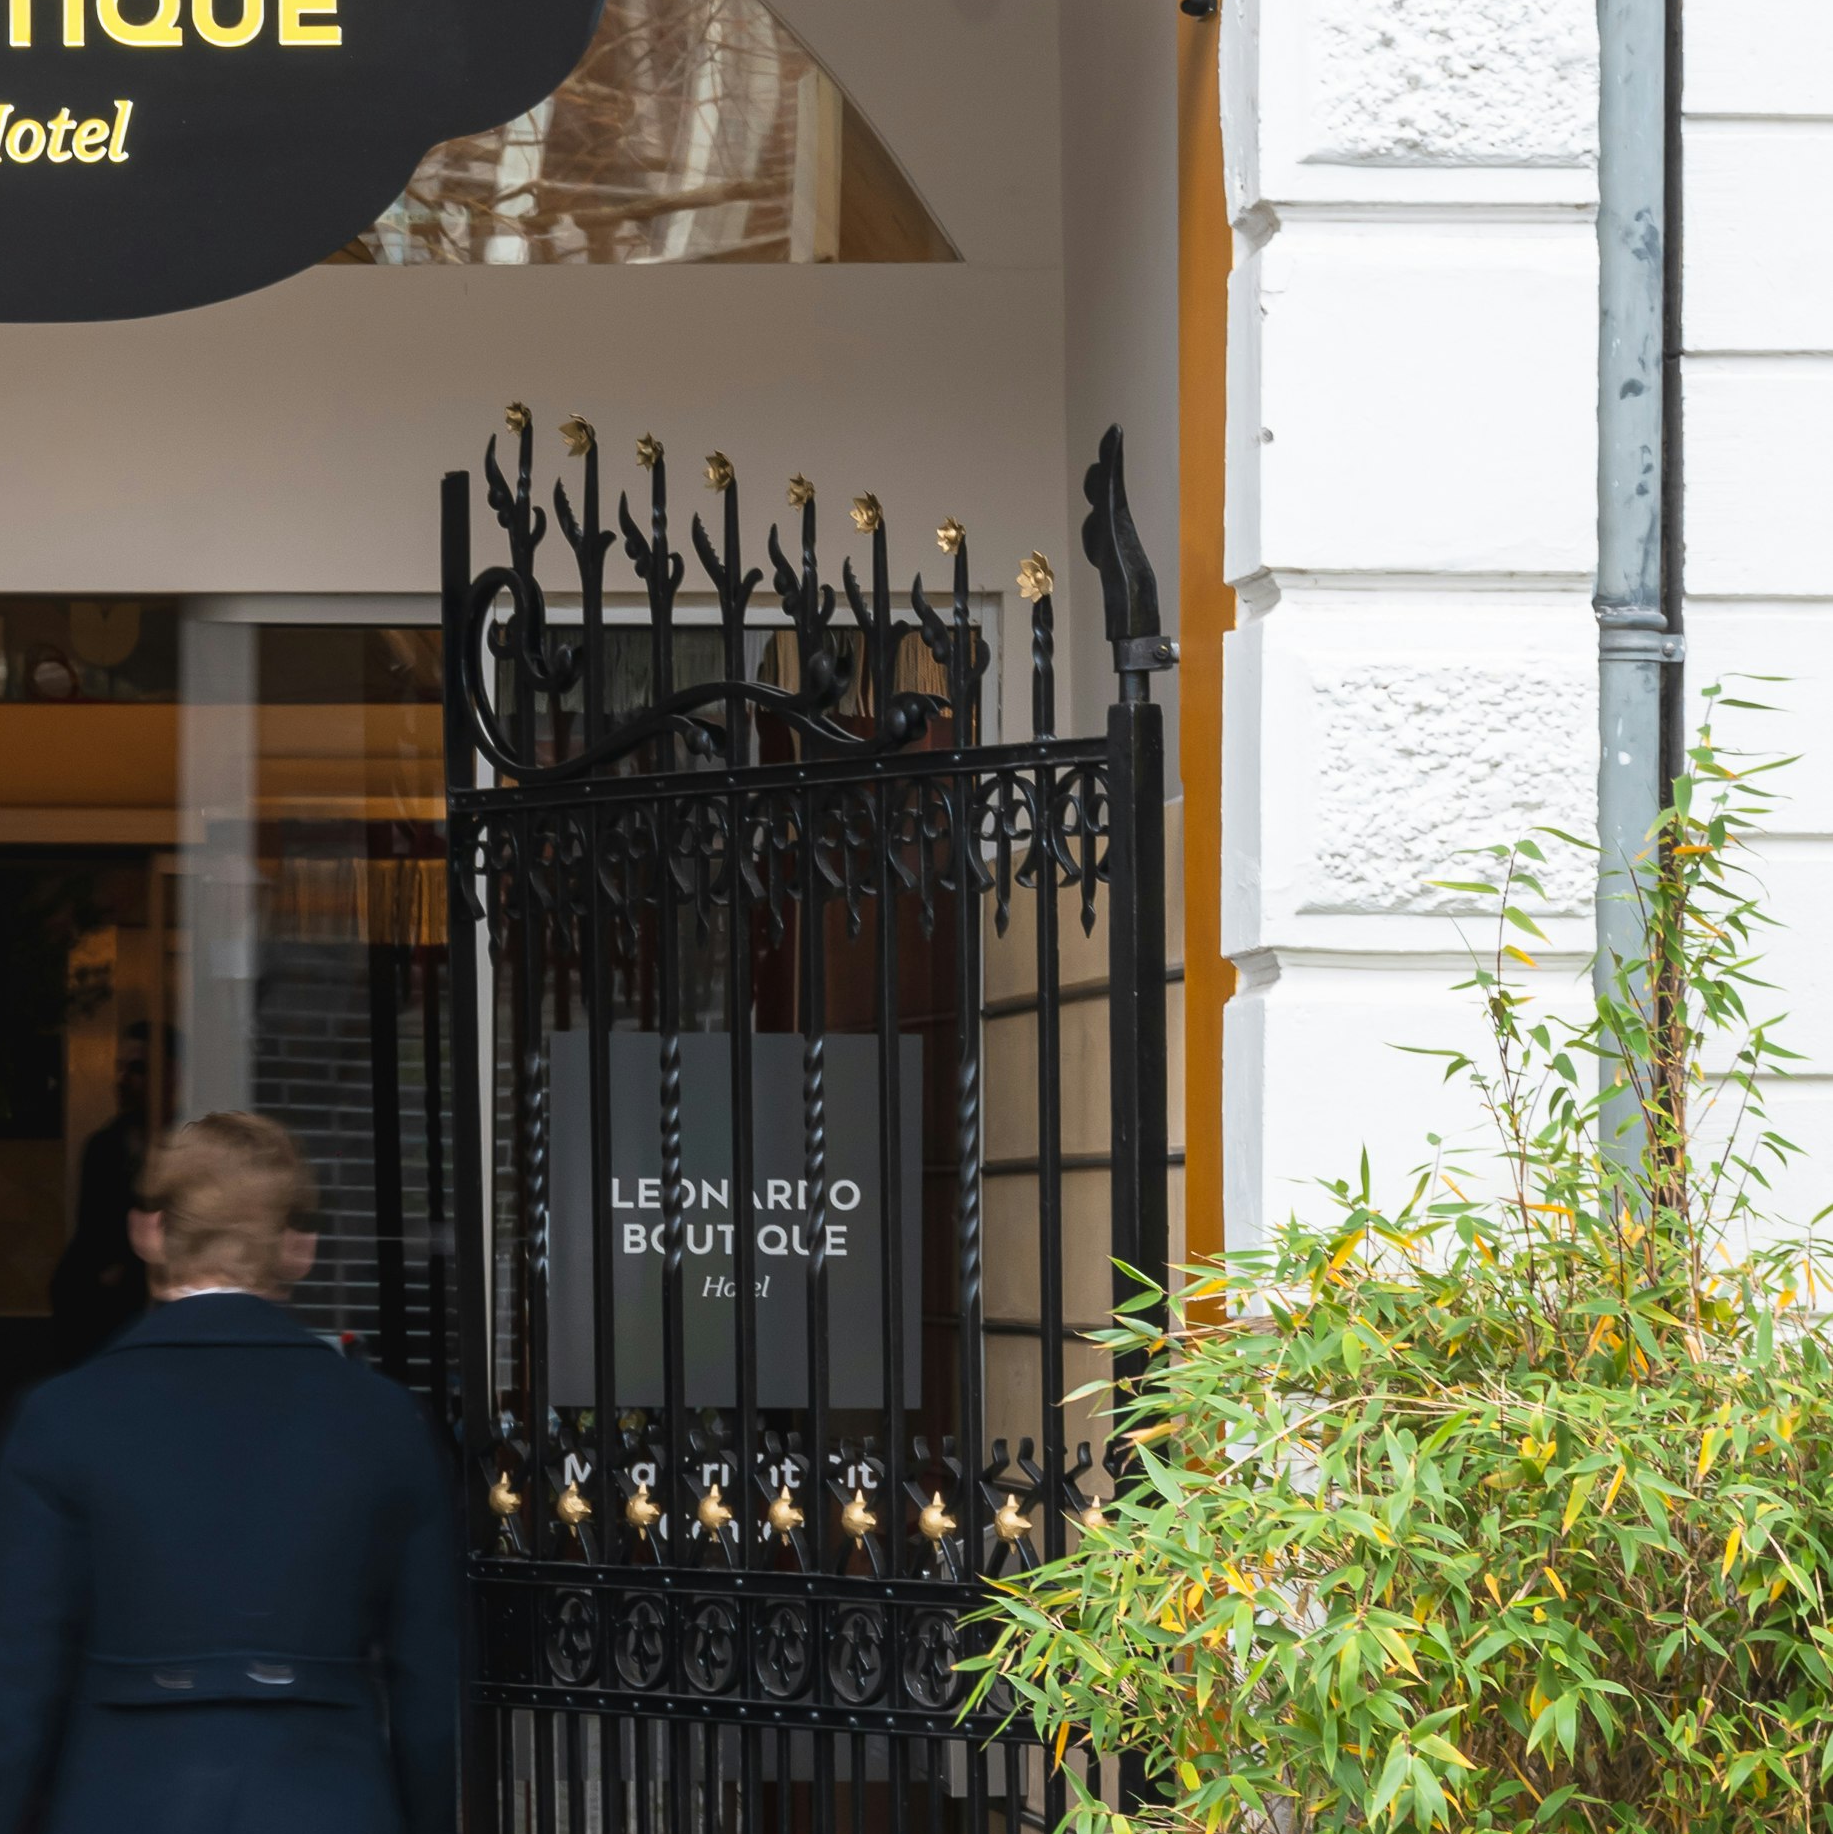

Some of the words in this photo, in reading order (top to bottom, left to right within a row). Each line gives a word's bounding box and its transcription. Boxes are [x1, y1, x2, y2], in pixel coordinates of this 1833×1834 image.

[612, 1178, 861, 1210] LENRO
[623, 1224, 847, 1256] BUTQUE
[702, 1274, 771, 1298] Hoel
